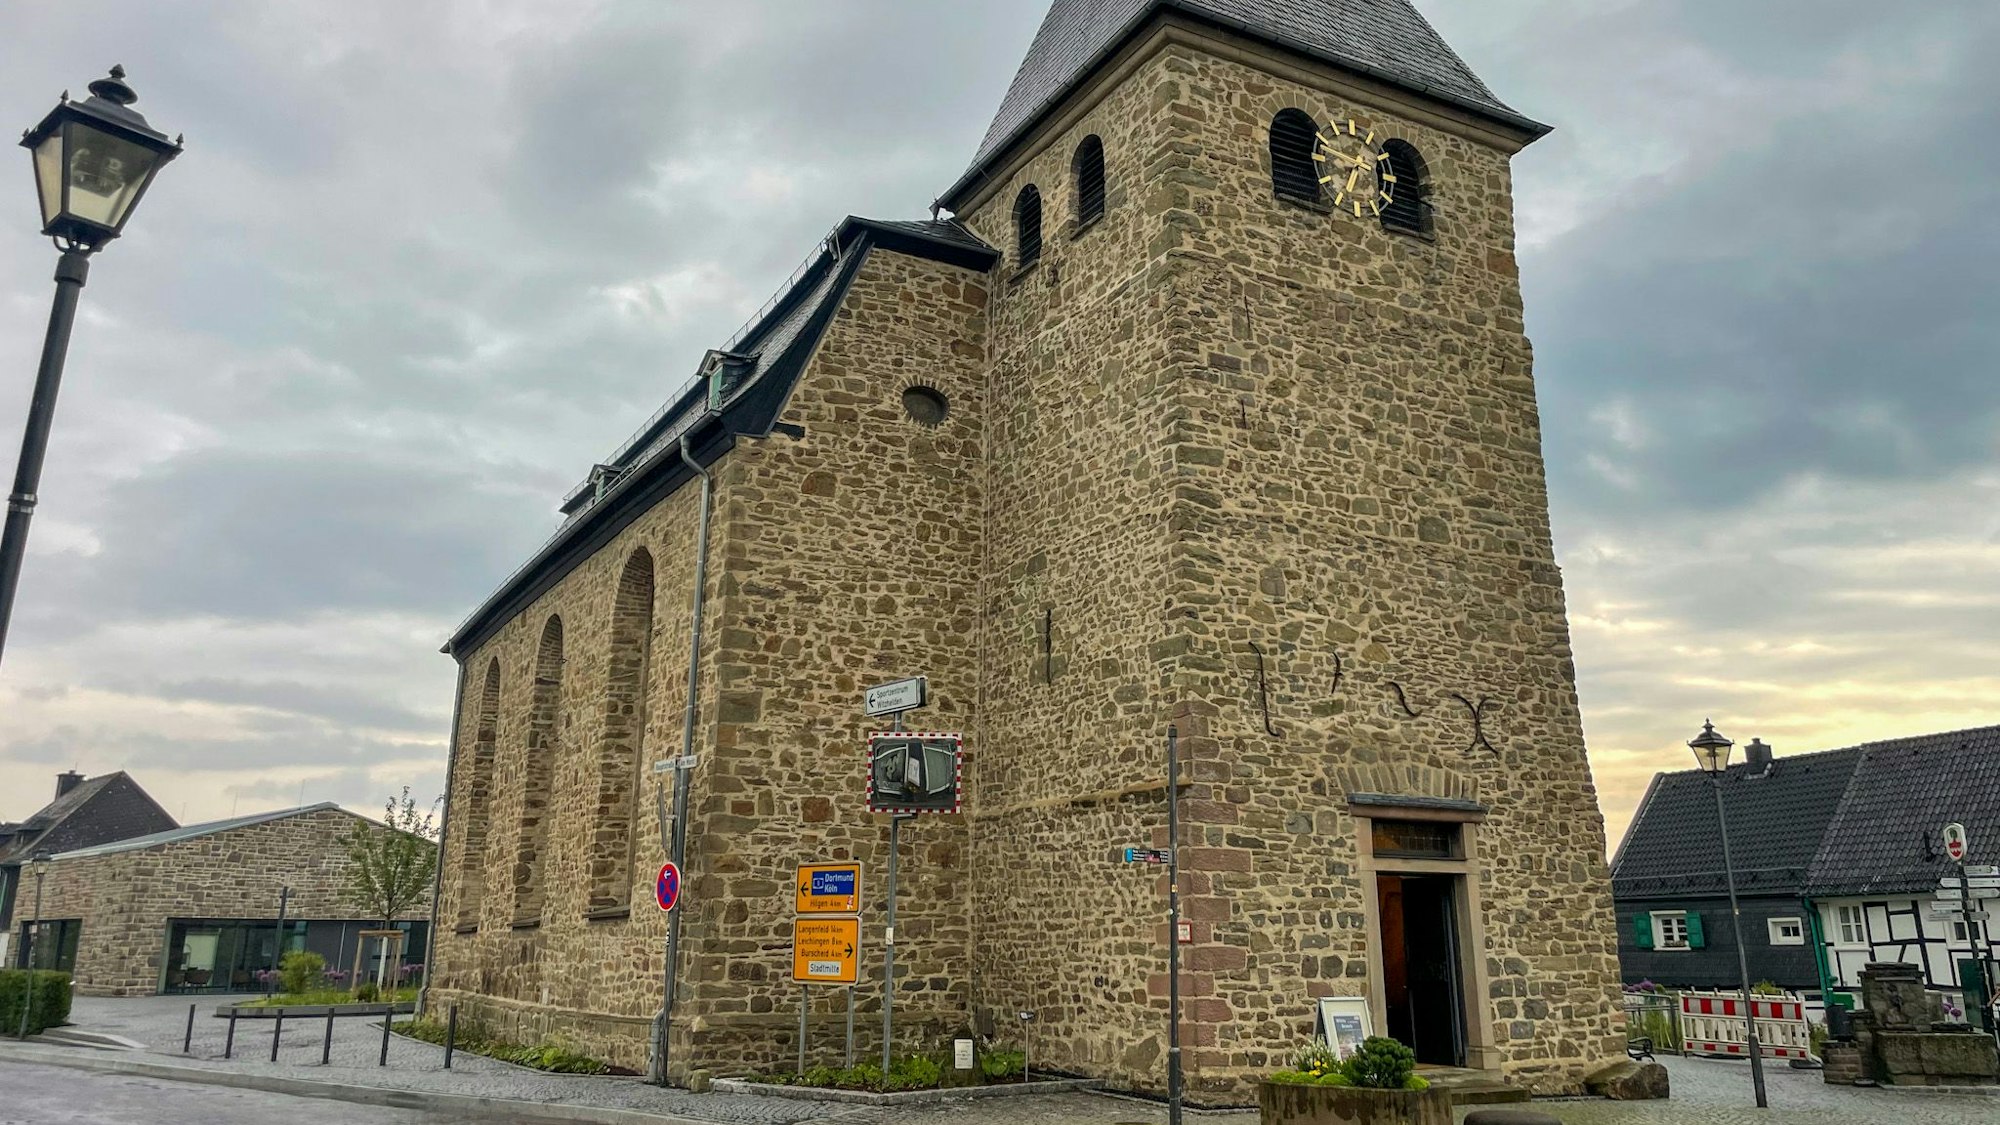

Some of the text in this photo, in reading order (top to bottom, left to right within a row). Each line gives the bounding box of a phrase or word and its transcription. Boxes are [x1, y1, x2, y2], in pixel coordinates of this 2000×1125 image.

[877, 686, 908, 698] Sportzentrum
[824, 873, 854, 882] Dortmund
[824, 884, 838, 893] Köln
[810, 898, 828, 909] Hilgen
[798, 925, 829, 935] Langenfeld
[798, 937, 829, 947] Leichlingen
[801, 948, 829, 957] Burscheid
[810, 963, 839, 973] Stadtmitte
